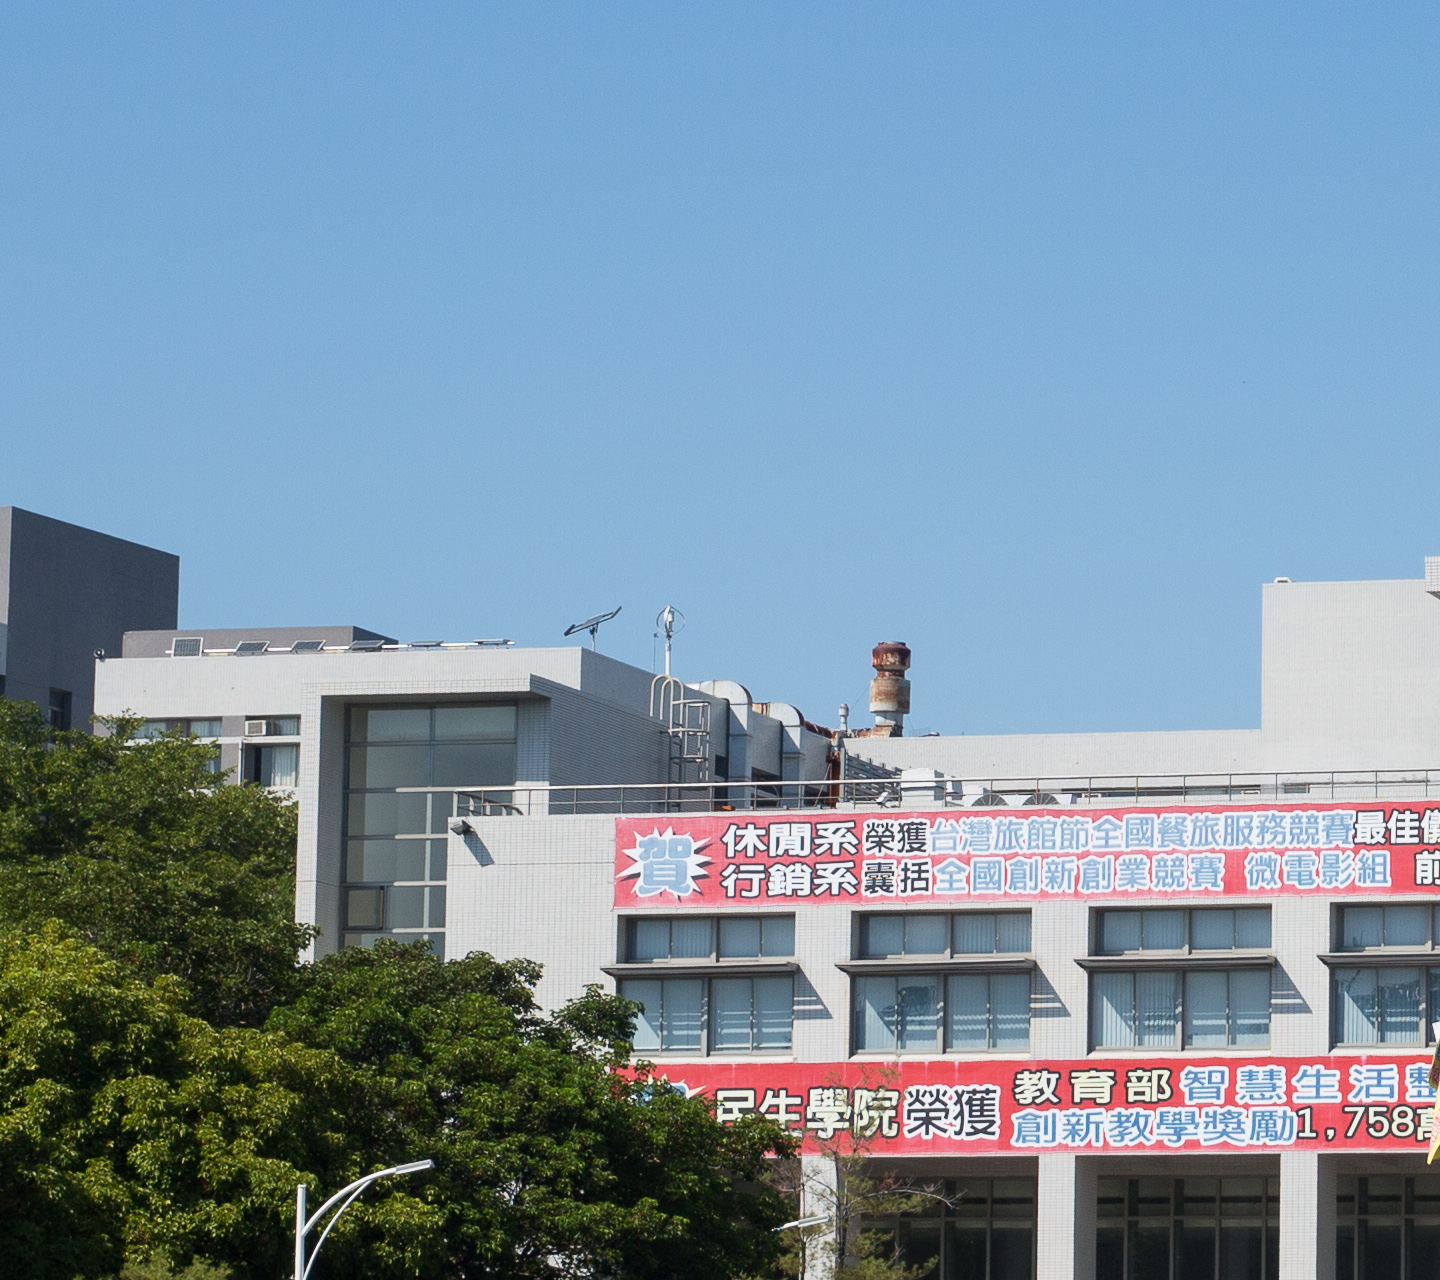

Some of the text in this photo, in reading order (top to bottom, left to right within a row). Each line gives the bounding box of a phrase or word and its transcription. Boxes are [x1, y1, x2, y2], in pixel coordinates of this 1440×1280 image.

[639, 835, 694, 898] 賀
[1246, 850, 1391, 888] 微電影組
